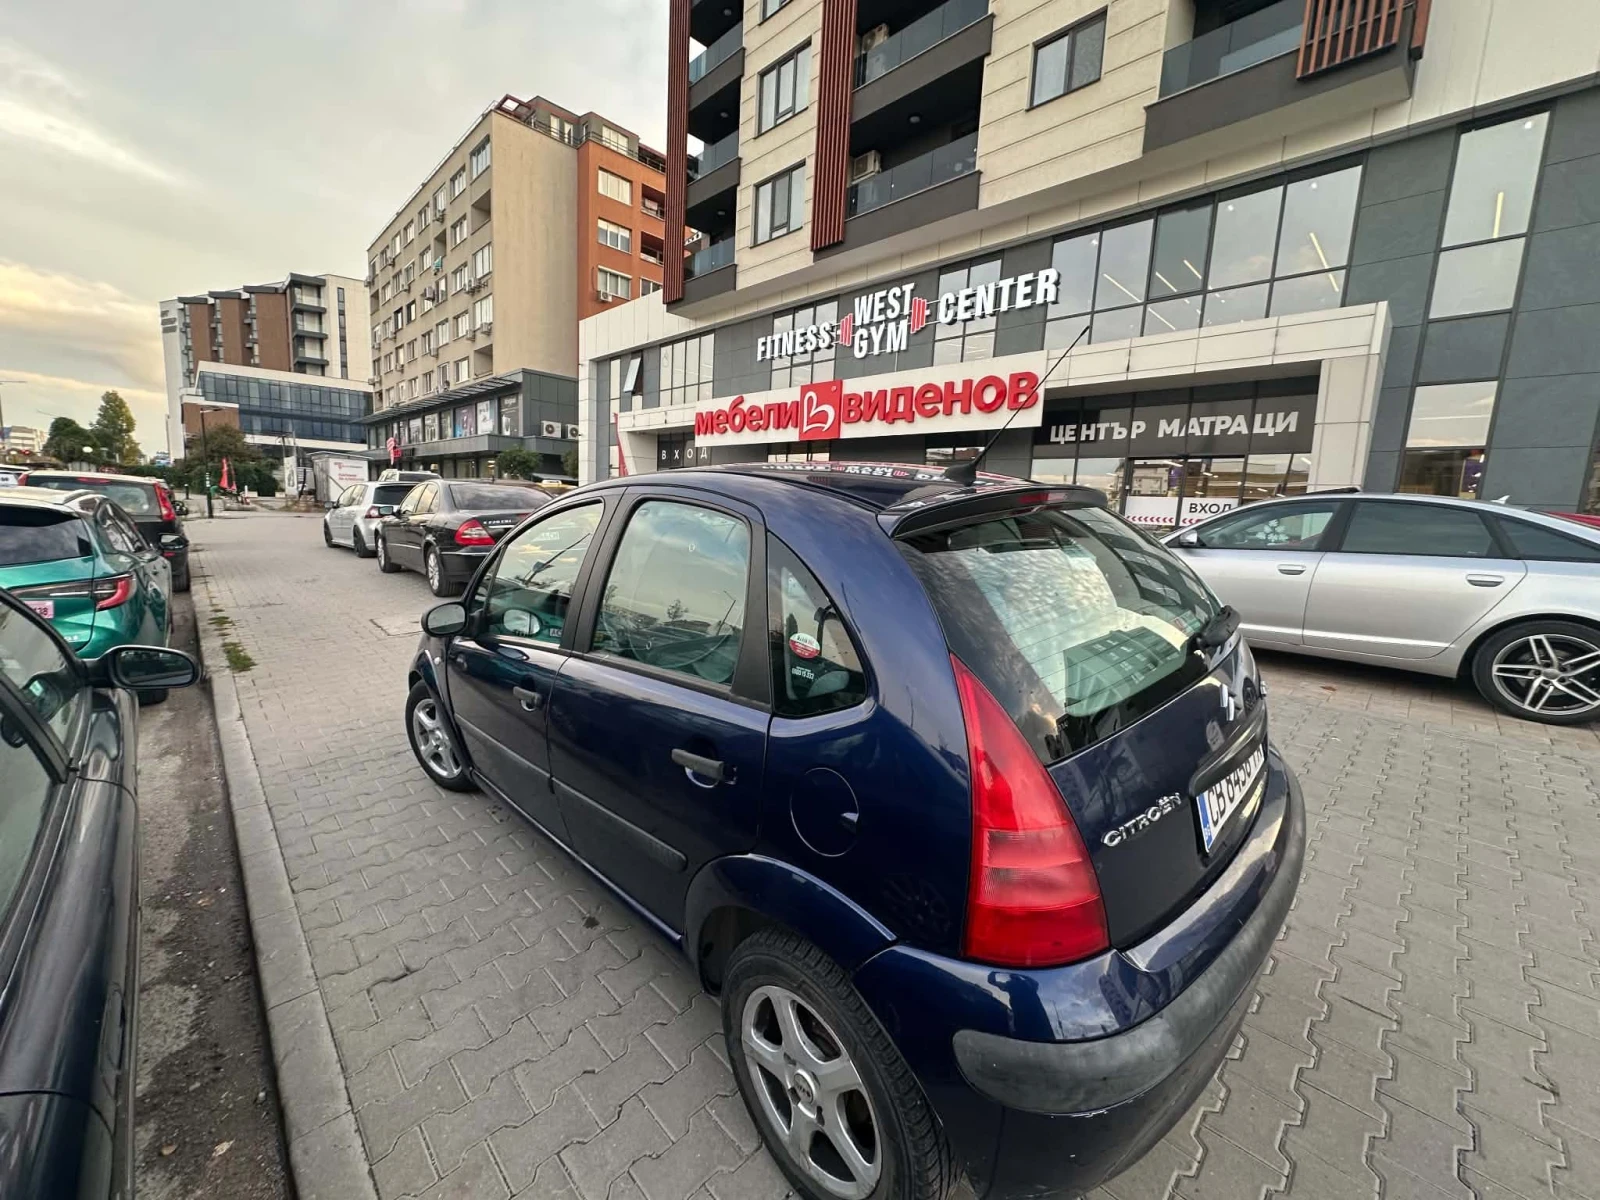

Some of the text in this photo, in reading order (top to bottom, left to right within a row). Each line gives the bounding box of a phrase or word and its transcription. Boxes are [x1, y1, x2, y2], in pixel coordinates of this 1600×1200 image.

[854, 282, 915, 327] WEST
[938, 267, 1061, 325] CENTER
[757, 321, 832, 361] FITNESS
[853, 318, 909, 359] GYM
[694, 395, 799, 436] мебели
[1050, 411, 1299, 444] ЦЕНТЪР МАТРАЦИ
[661, 447, 708, 460] ВХОД
[1189, 503, 1232, 514] ВХОД
